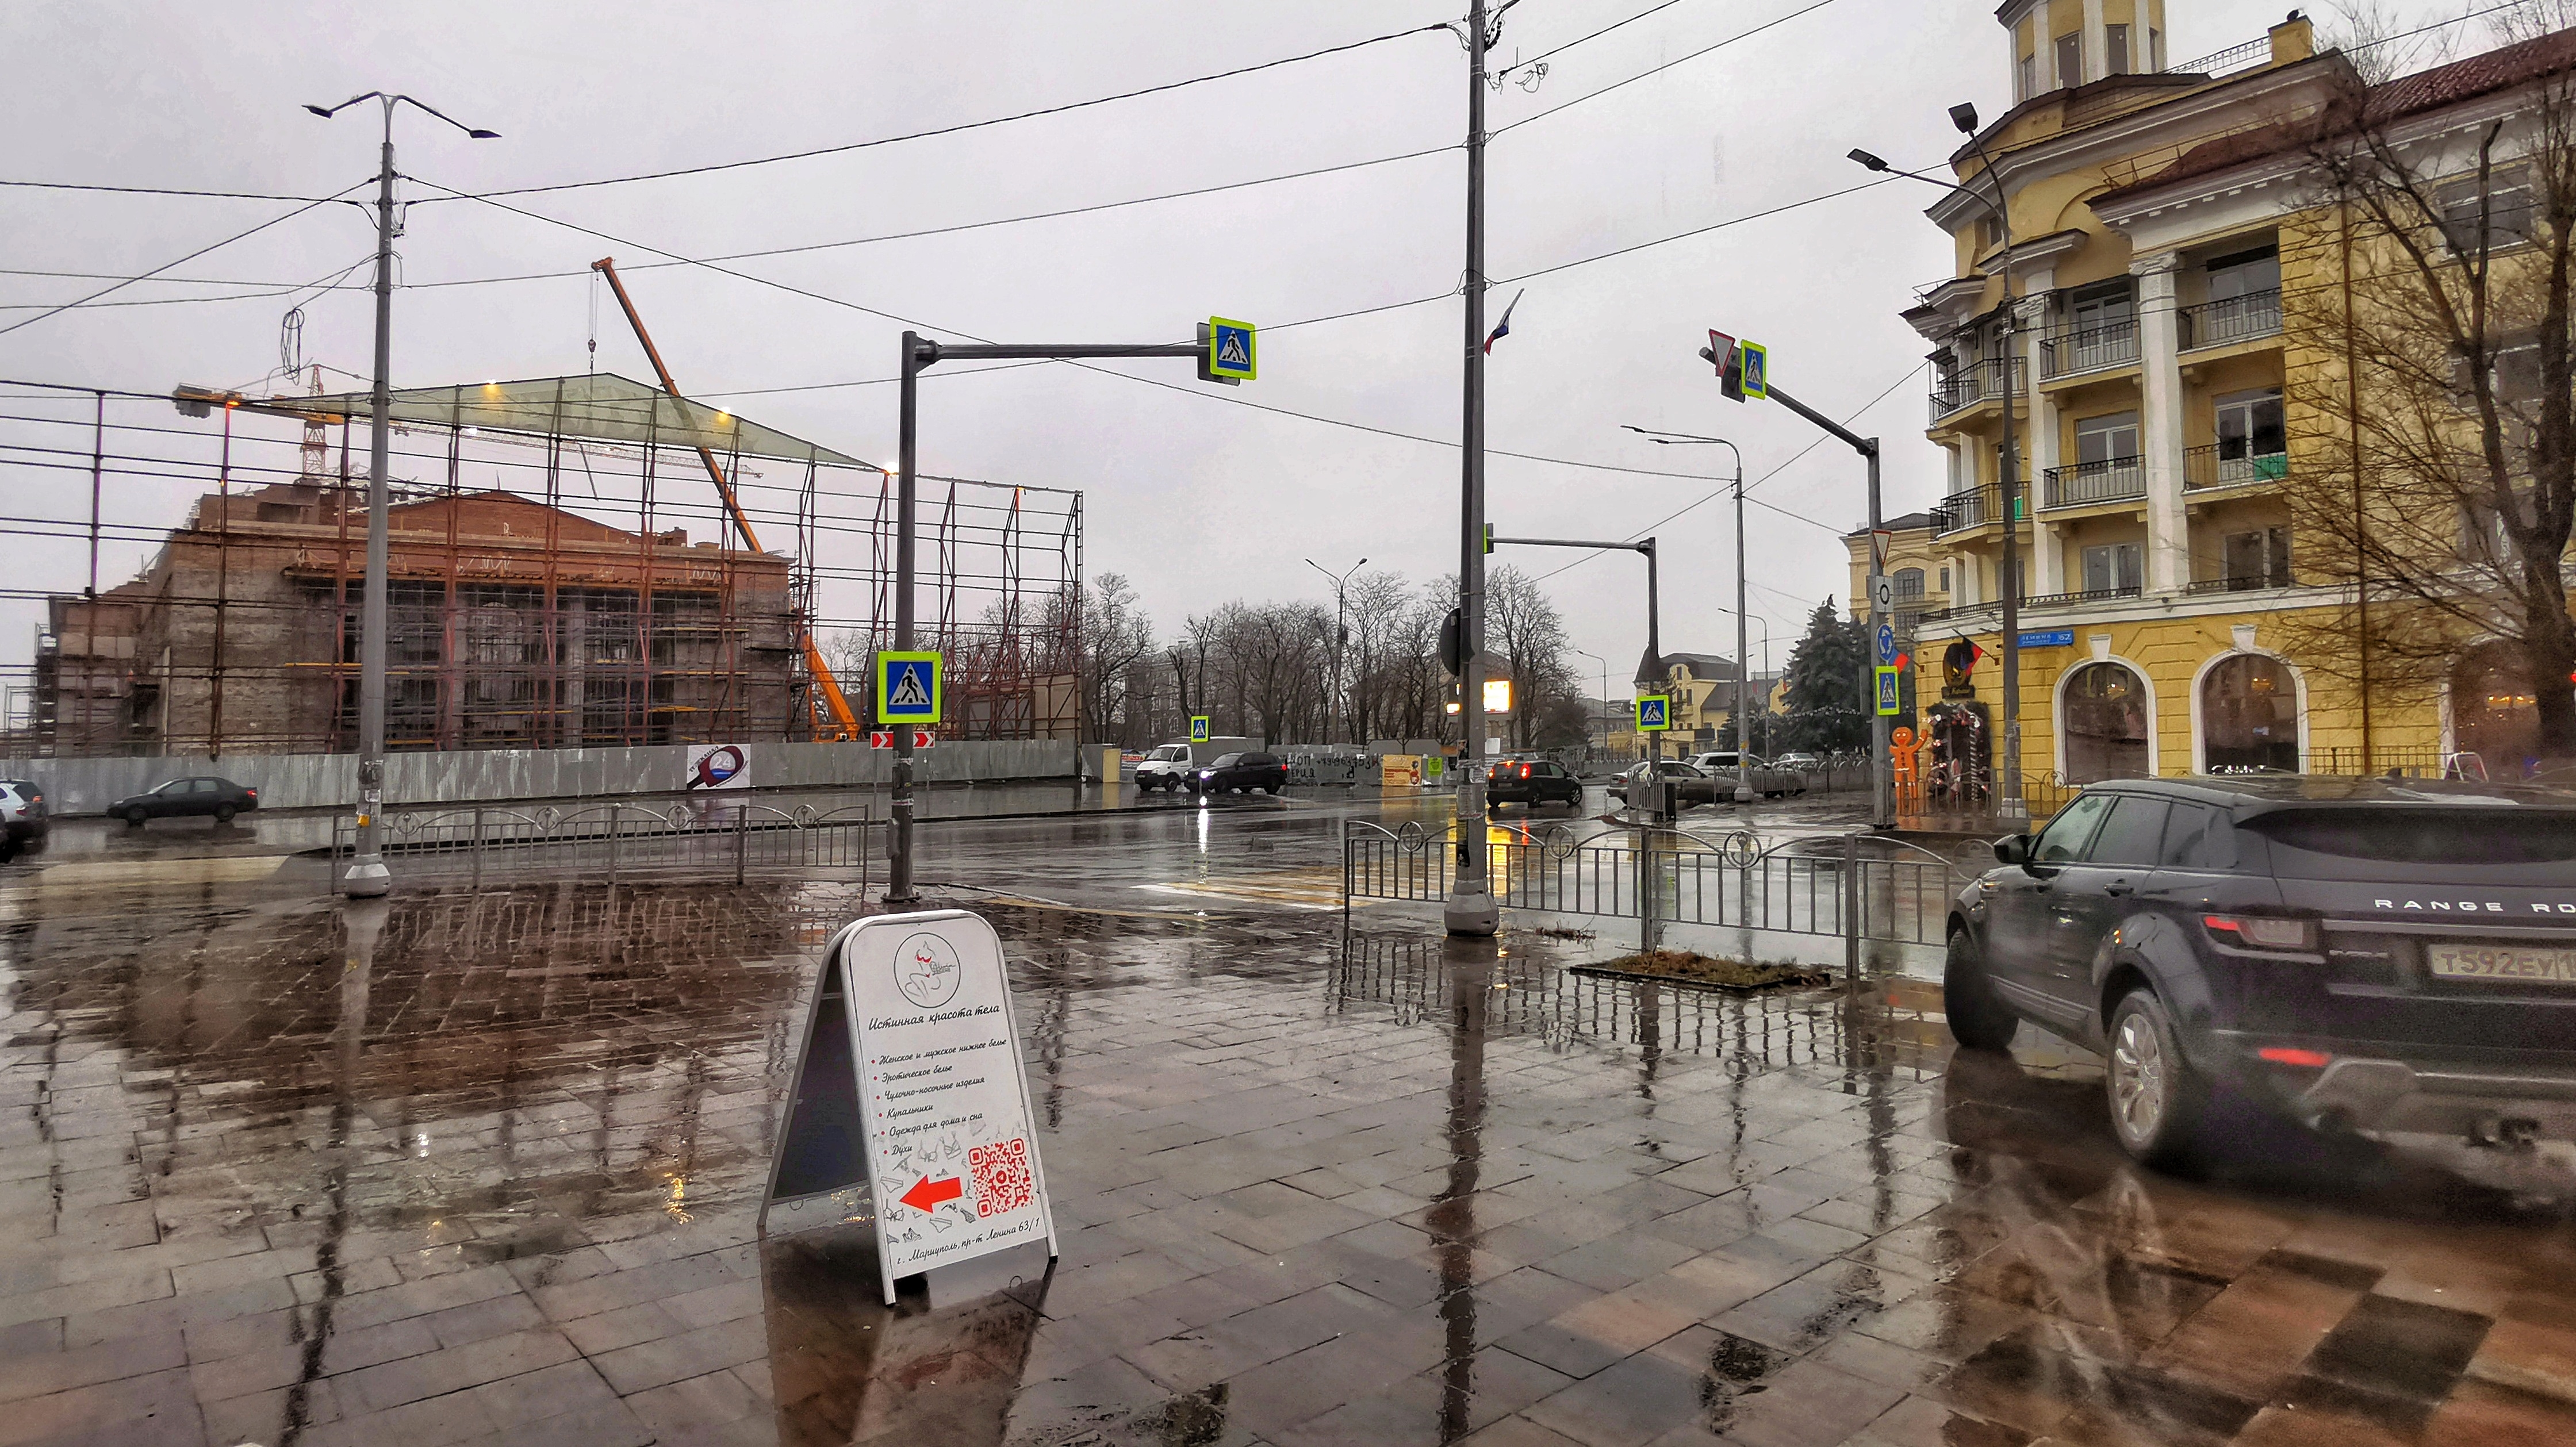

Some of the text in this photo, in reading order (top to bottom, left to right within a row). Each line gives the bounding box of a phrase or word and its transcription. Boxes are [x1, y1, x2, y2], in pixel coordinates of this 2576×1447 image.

[713, 755, 731, 769] 24
[2374, 899, 2504, 912] RANGE
[868, 1005, 1000, 1031] Истинная красота тела
[879, 1054, 913, 1065] Женское
[923, 1047, 956, 1060] мужское
[959, 1042, 986, 1053] нижнее
[988, 1038, 1007, 1047] белье
[881, 1065, 953, 1085] Эротическое белье
[884, 1076, 985, 1103] Чулочно-носочные изделия
[886, 1104, 933, 1120] Купальники
[889, 1125, 921, 1138] Одежда
[922, 1121, 937, 1133] для
[940, 1117, 960, 1130] дома
[969, 1112, 983, 1120] сна
[891, 1144, 913, 1157] Духи
[908, 1242, 960, 1262] Мариуполь,
[961, 1234, 983, 1252] пр-т
[986, 1226, 1017, 1241] Ленина
[1018, 1217, 1040, 1232] 63/1
